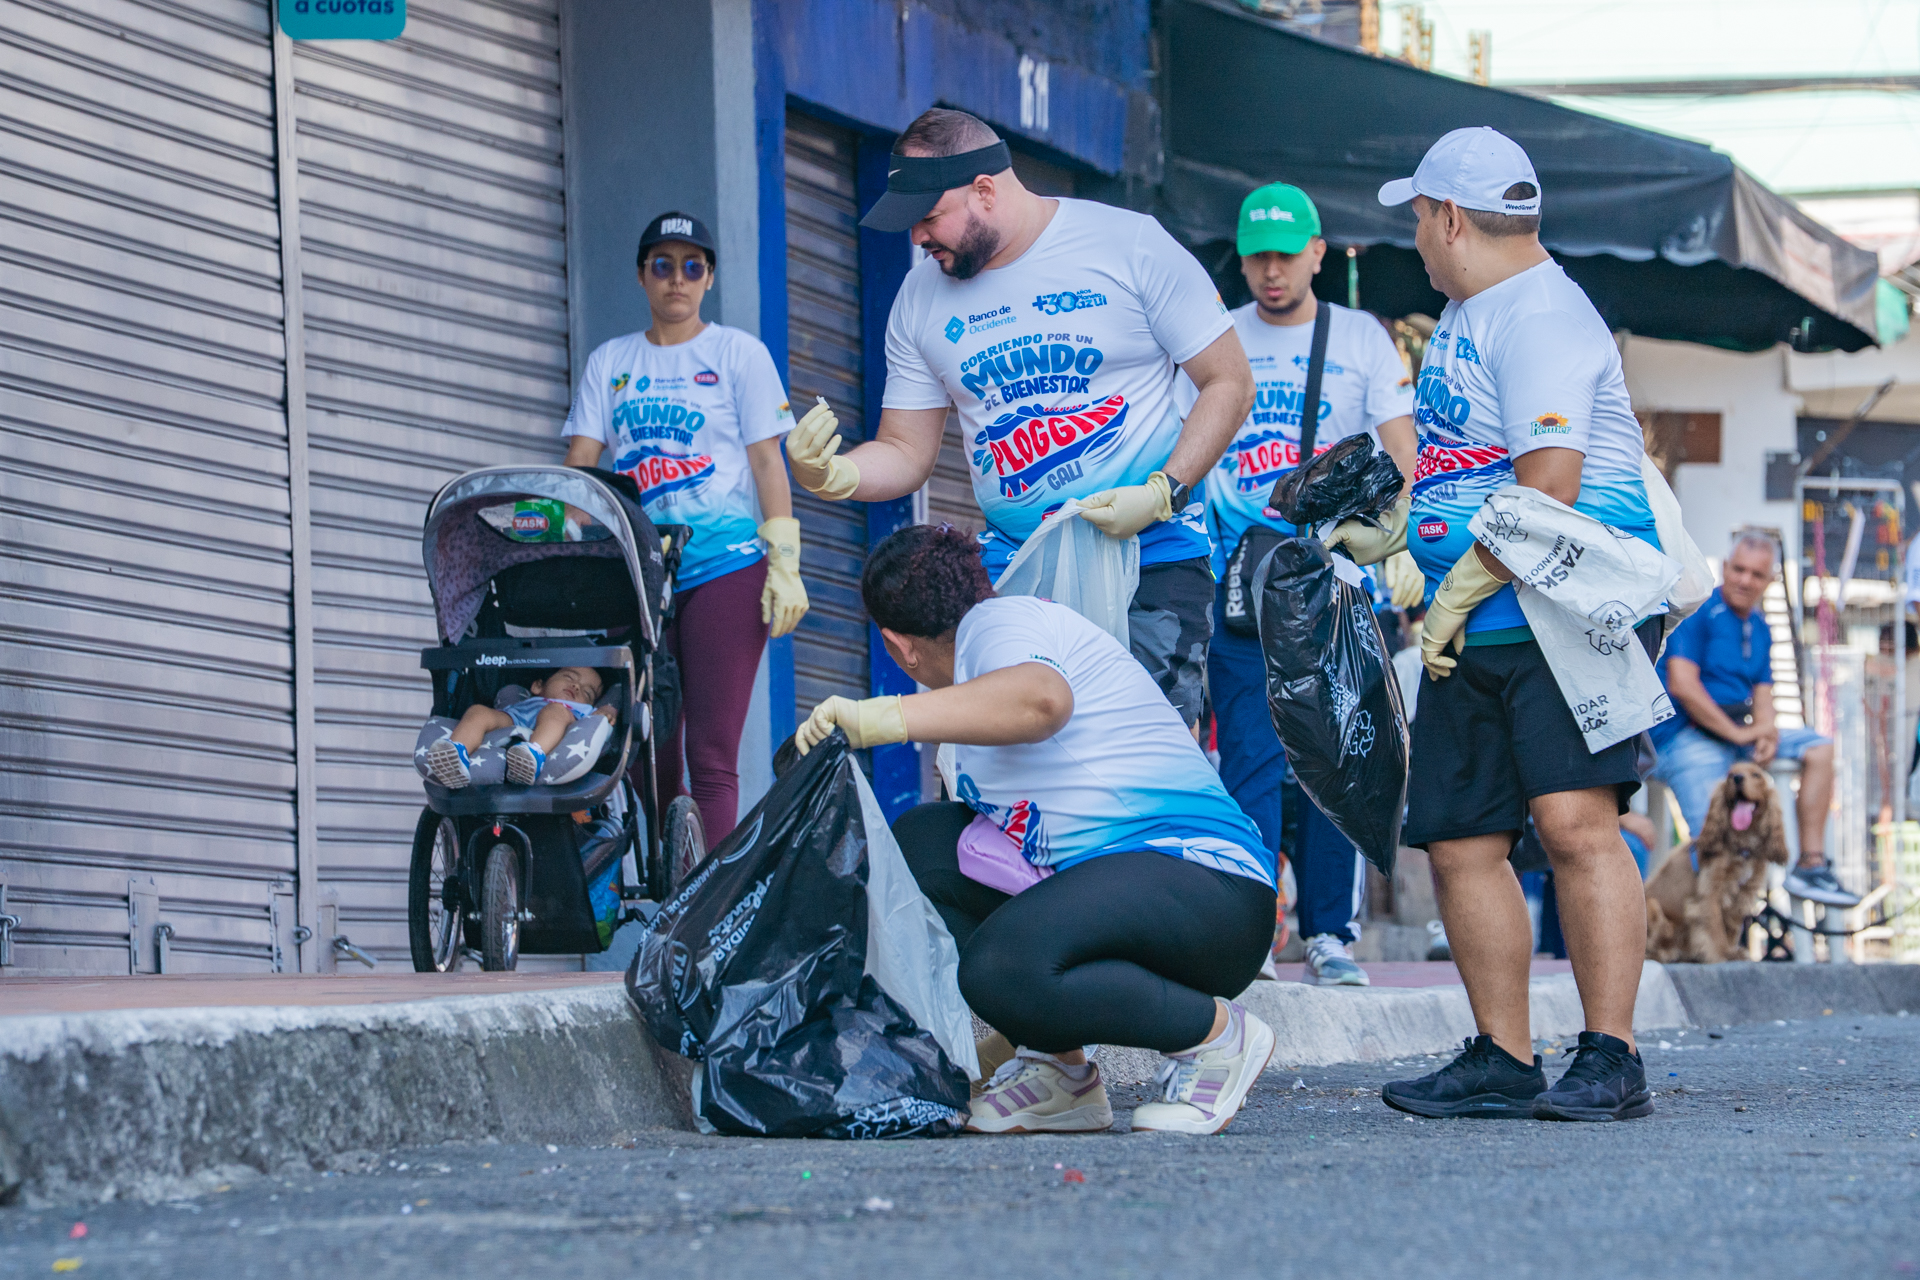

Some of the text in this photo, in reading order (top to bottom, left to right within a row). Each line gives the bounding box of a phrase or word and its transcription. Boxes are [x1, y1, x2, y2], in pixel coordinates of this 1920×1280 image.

[315, 0, 394, 14] cuotas
[968, 305, 1011, 324] Banco de
[969, 315, 1017, 335] Occidente
[960, 333, 1093, 373] CORRIENDO POR UN
[960, 344, 1104, 401] MUNDO
[984, 375, 1090, 412] DE BIENESTAR
[612, 404, 705, 434] MUNDO
[1530, 422, 1572, 436] Premier
[630, 426, 694, 447] BIENESTAR
[989, 394, 1125, 476] PLOGGING
[616, 455, 712, 494] LOGGING
[1047, 460, 1084, 491] CALI
[656, 493, 678, 512] CALI
[515, 518, 544, 529] TASK
[1419, 525, 1445, 535] TASK
[1539, 542, 1586, 590] TASK
[475, 653, 507, 667] Jeep
[1572, 694, 1609, 716] IDAR
[709, 857, 720, 873] UN
[679, 868, 710, 902] MUNDO
[665, 899, 681, 915] DE
[672, 953, 688, 999] TAS
